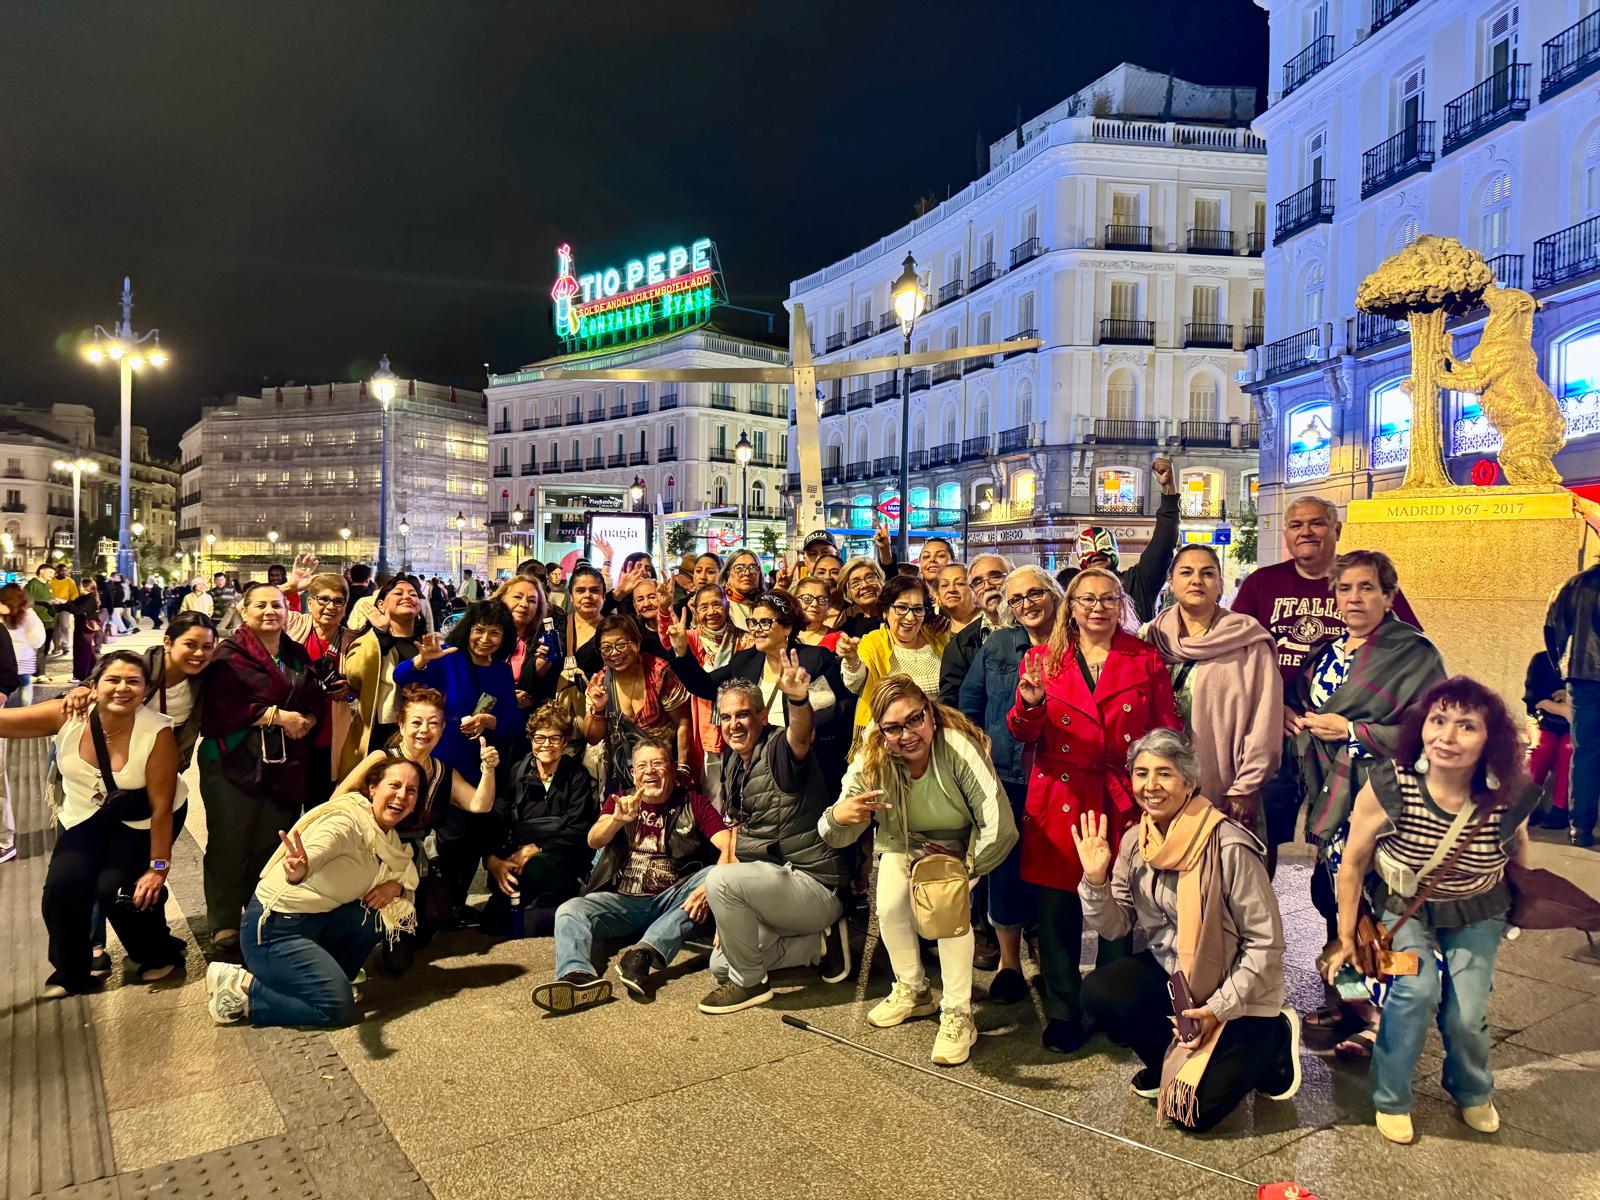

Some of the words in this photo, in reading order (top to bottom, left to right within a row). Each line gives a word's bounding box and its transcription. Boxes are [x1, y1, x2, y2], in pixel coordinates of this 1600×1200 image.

[579, 267, 620, 303] TIO
[627, 239, 711, 290] PEPE
[579, 306, 595, 317] SOL
[595, 304, 606, 313] DE
[607, 293, 647, 311] ANDALUCIA
[649, 274, 709, 299] EMBOTELLADO
[888, 504, 901, 512] Metr
[1387, 505, 1445, 517] MADRID
[1450, 504, 1479, 516] 1967
[1494, 502, 1525, 515] 2017
[557, 527, 585, 537] renfe
[600, 528, 638, 539] magia
[1000, 529, 1023, 540] DIEGO
